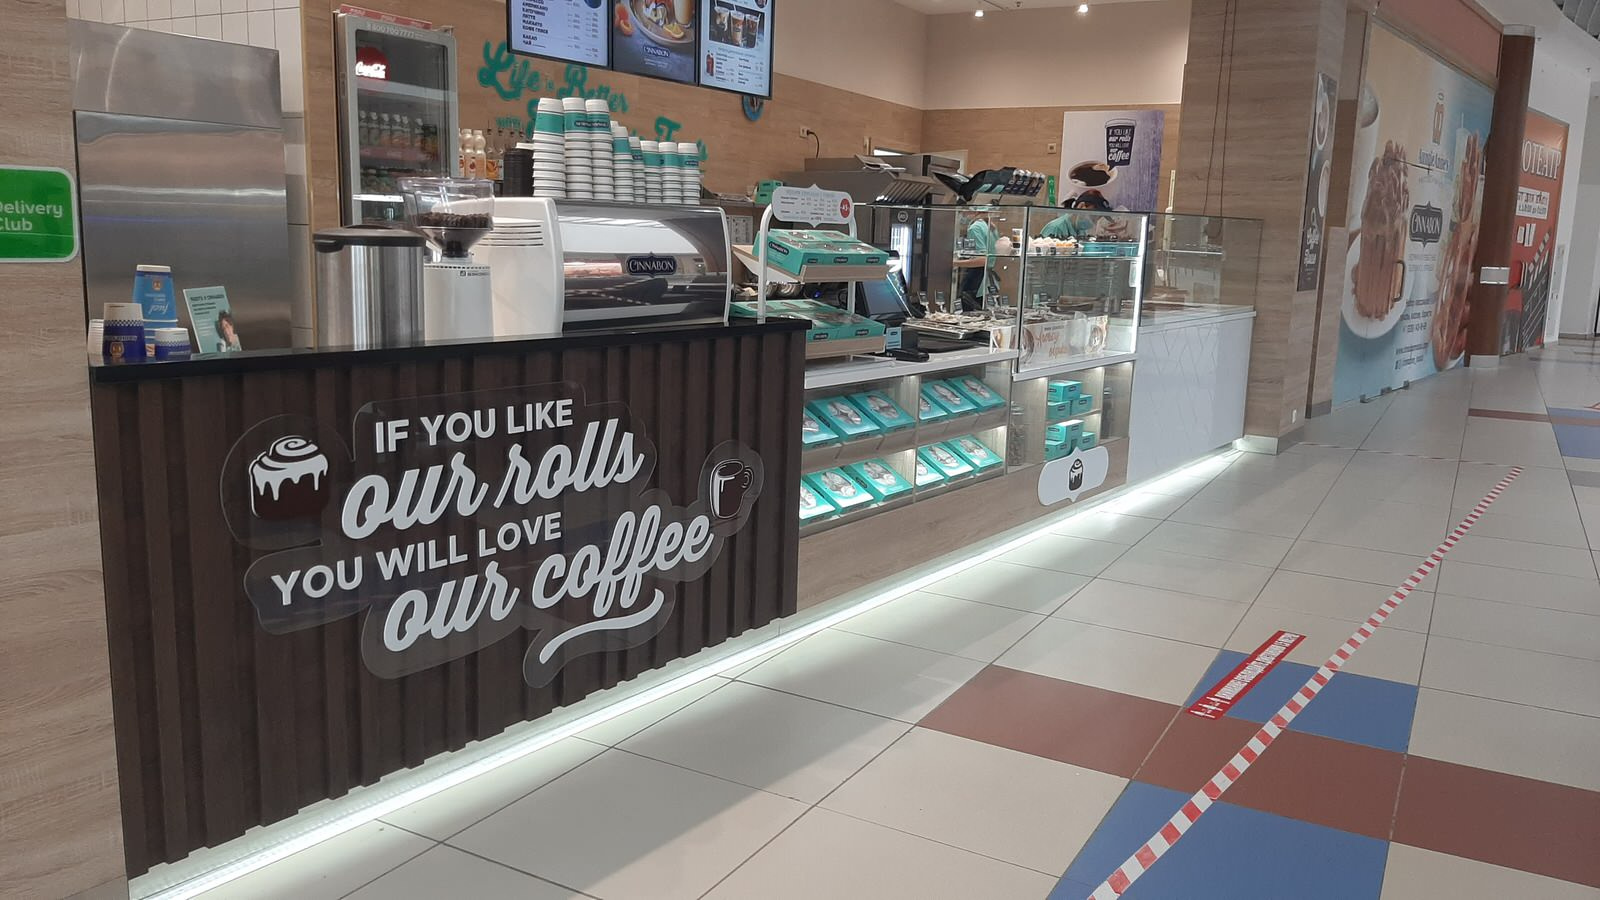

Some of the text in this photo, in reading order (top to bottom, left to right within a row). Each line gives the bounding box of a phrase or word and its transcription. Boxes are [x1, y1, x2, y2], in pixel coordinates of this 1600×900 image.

[477, 41, 541, 101] Life
[1108, 150, 1130, 162] coffee
[1411, 212, 1440, 234] CINNABON
[629, 257, 674, 271] CINNABON
[375, 398, 574, 454] IF YOU LIKE
[341, 417, 645, 540] our rolls
[271, 512, 562, 606] YOU WILL LOVE
[382, 504, 714, 653] our coffee
